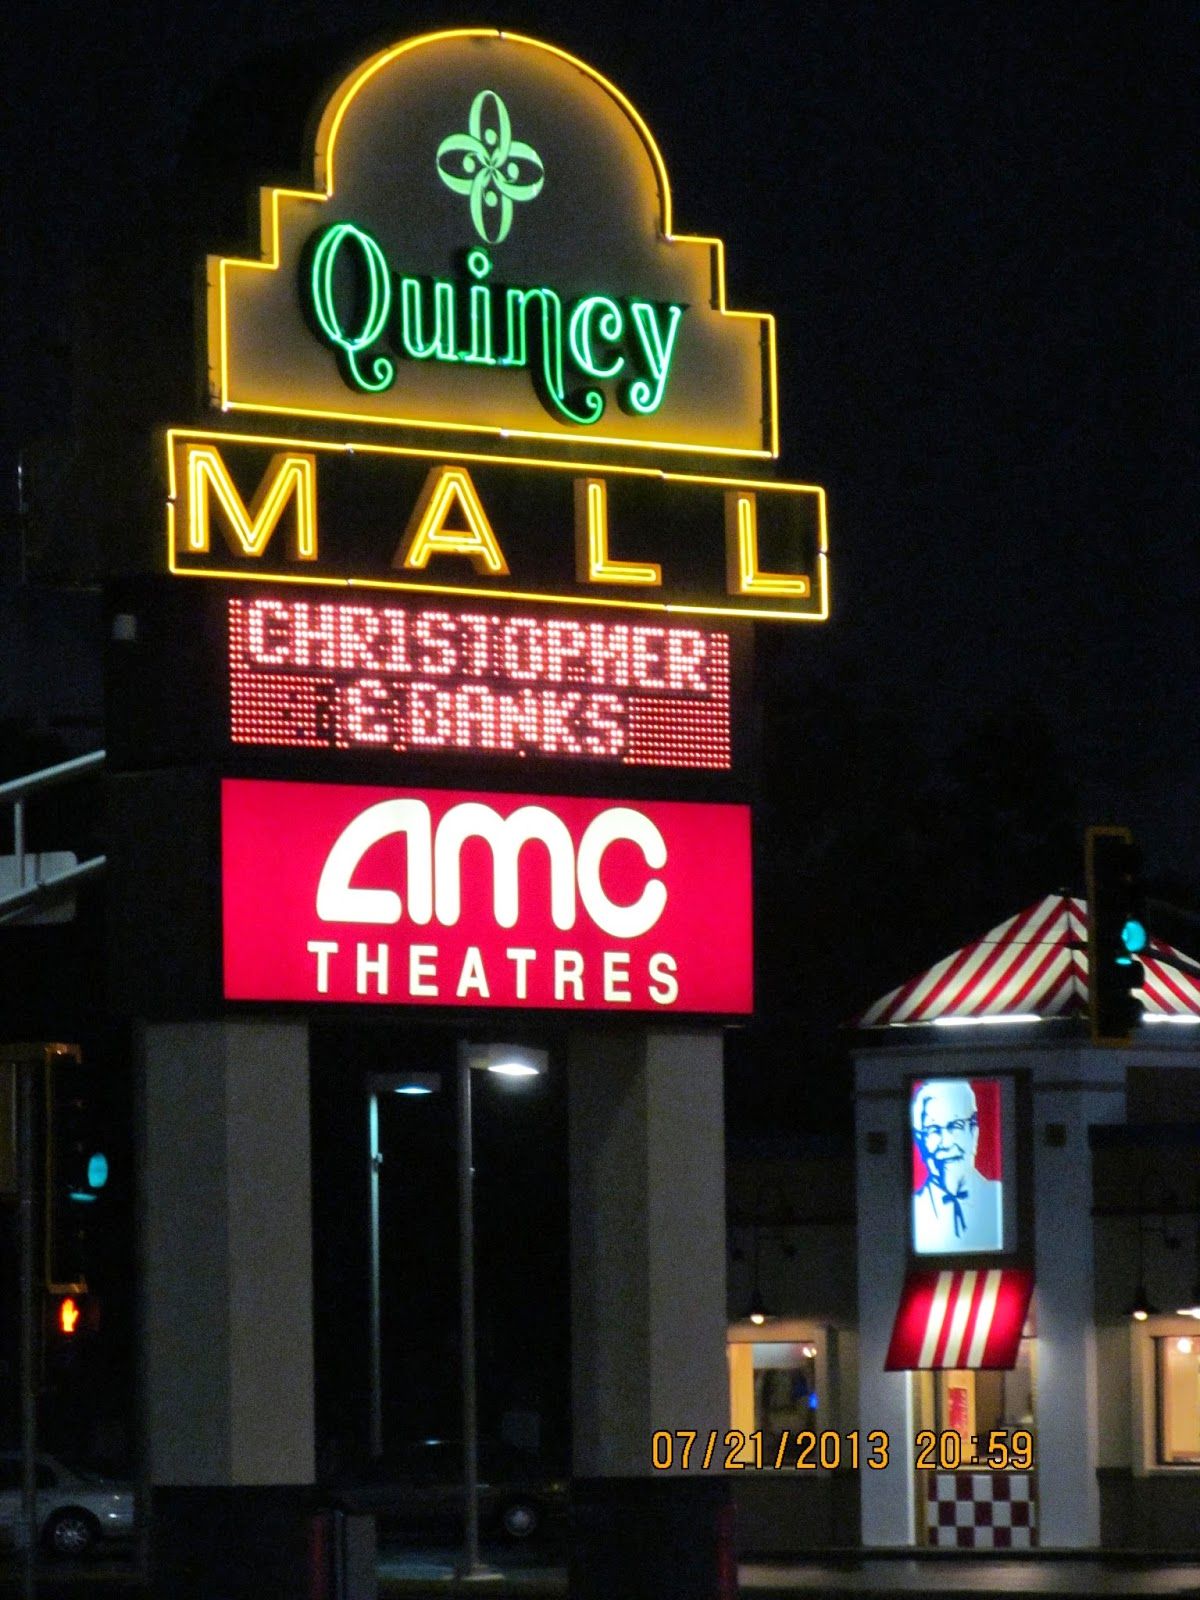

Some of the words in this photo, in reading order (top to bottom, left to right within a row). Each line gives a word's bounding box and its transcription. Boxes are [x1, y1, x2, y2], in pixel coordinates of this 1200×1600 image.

[311, 222, 684, 425] Quincy
[183, 443, 812, 597] MALL
[248, 600, 707, 691] CHRISTOPHER
[410, 682, 624, 755] BANKS
[306, 940, 679, 1004] THEATRES
